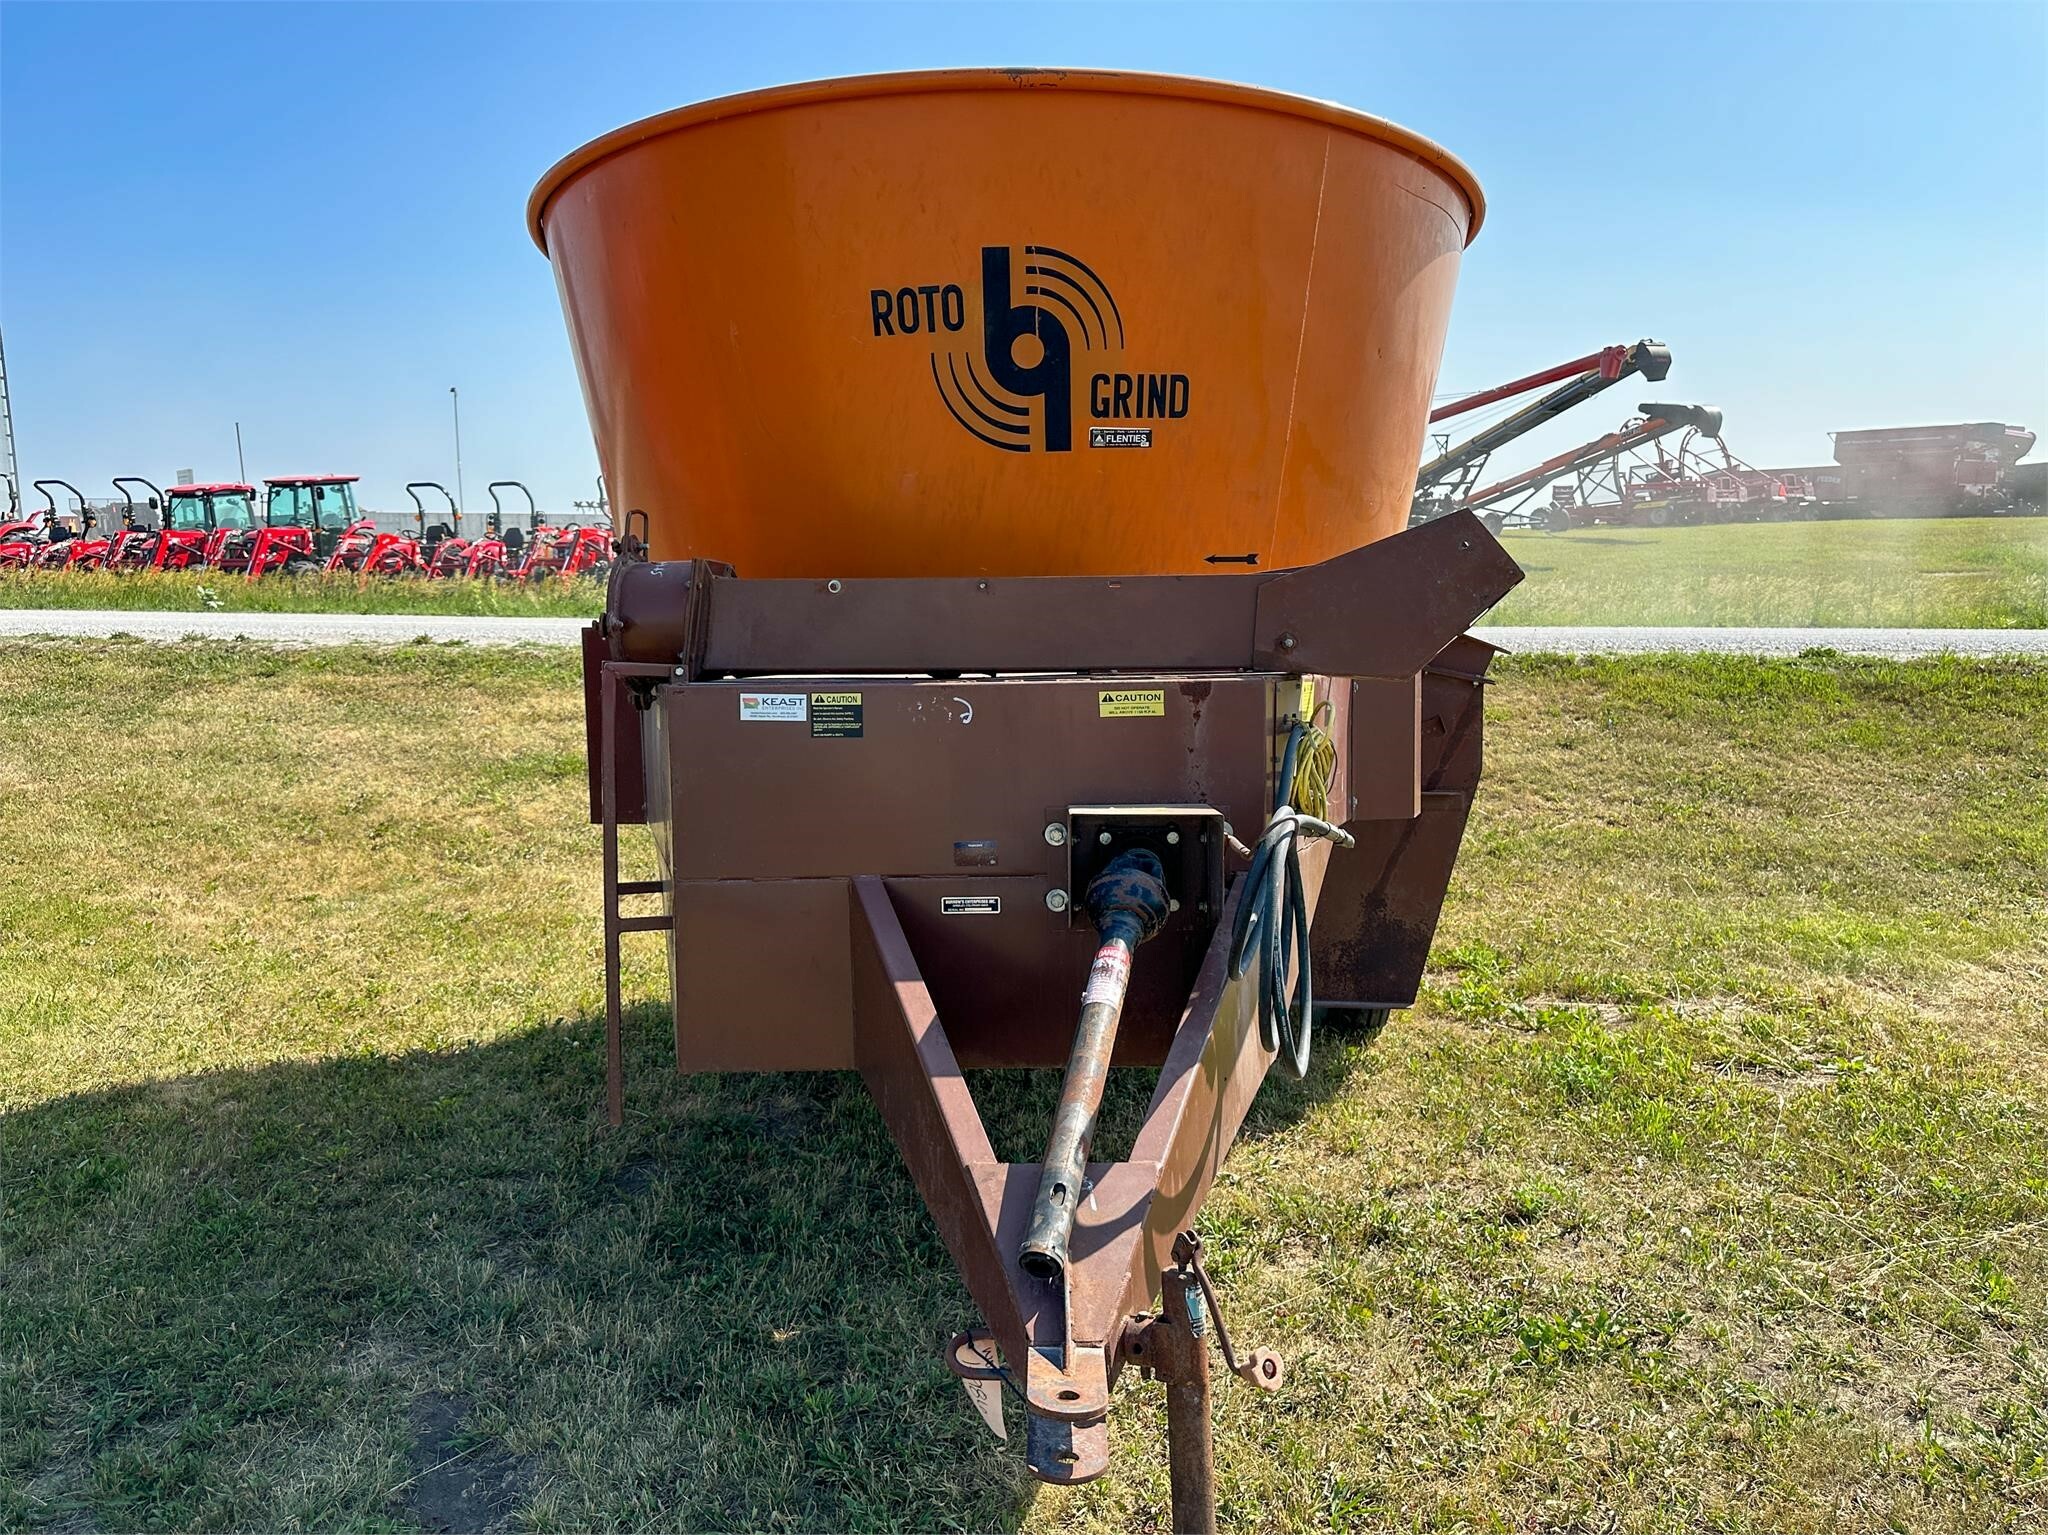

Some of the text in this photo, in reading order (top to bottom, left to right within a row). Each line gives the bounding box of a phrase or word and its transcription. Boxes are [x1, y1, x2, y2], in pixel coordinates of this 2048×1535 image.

[870, 284, 965, 337] ROTO
[1089, 373, 1190, 419] GRIND
[1106, 434, 1147, 443] FLENTIES
[762, 697, 805, 706] KEAST
[826, 695, 858, 704] CAUTION
[1115, 693, 1161, 702] CAUTION
